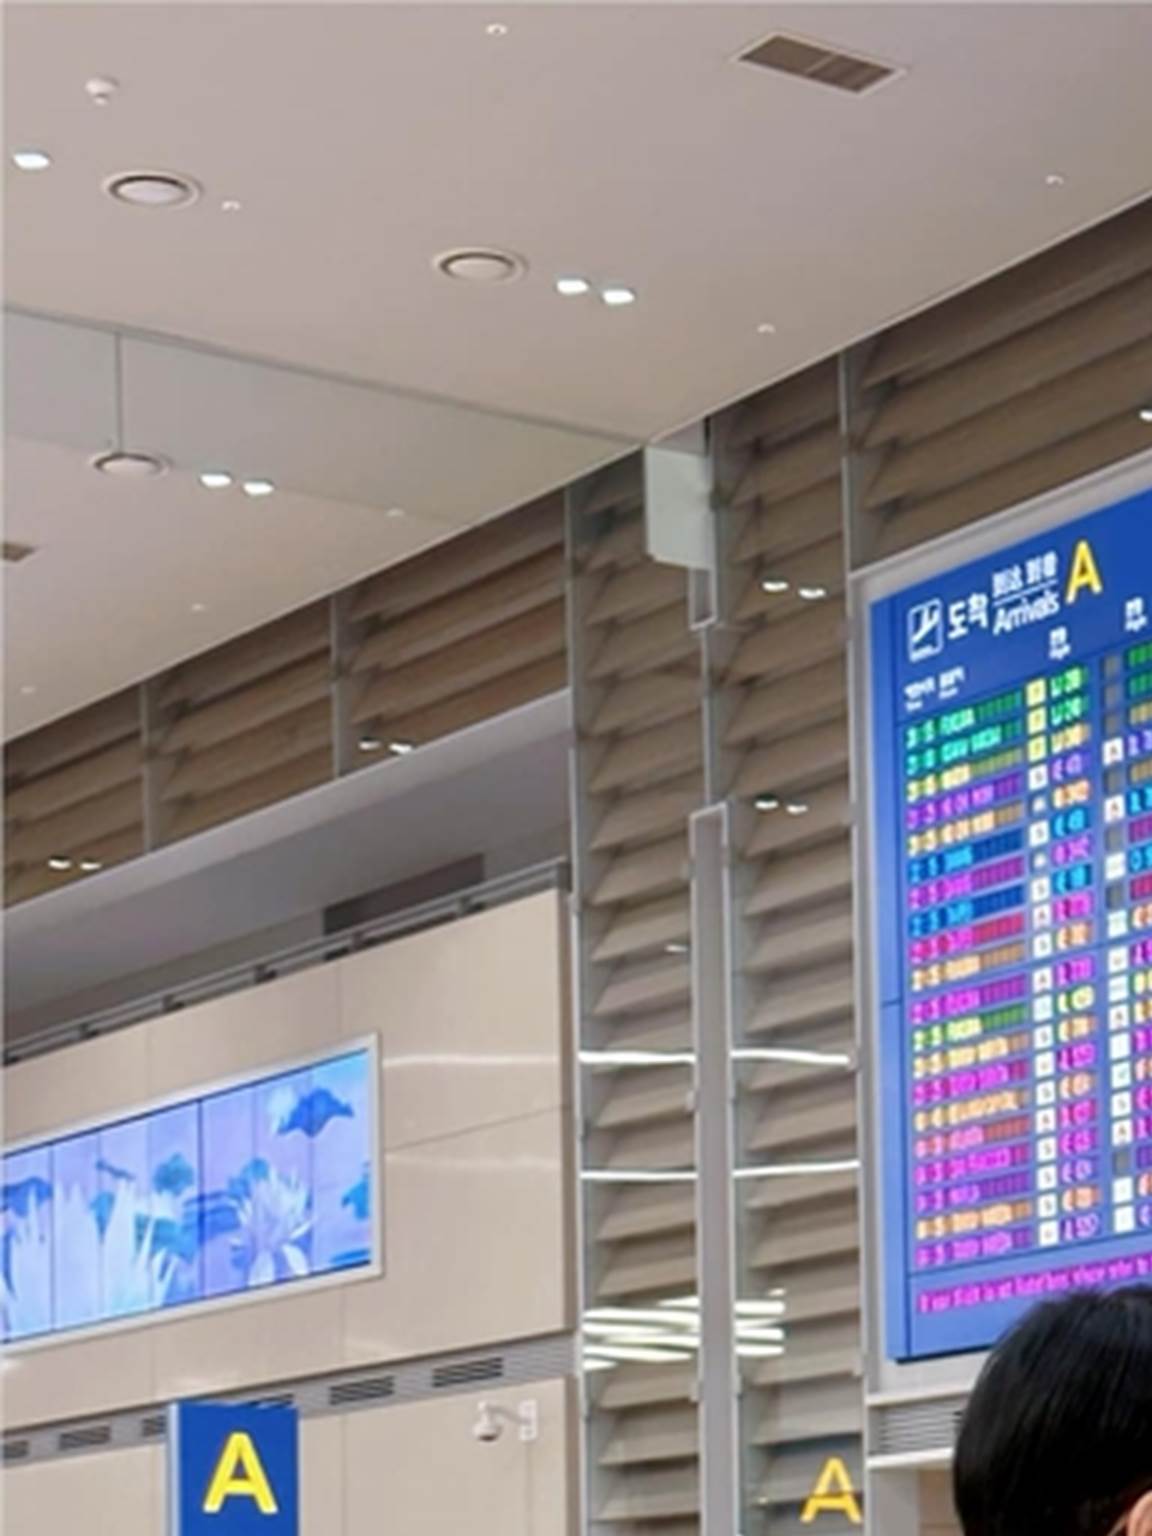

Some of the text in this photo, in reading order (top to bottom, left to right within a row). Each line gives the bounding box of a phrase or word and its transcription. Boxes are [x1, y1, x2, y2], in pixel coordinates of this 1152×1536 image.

[1066, 540, 1102, 604] A
[948, 592, 988, 640] 도착
[992, 590, 1060, 635] Arrivals
[202, 1432, 279, 1514] A
[800, 1457, 862, 1523] A
